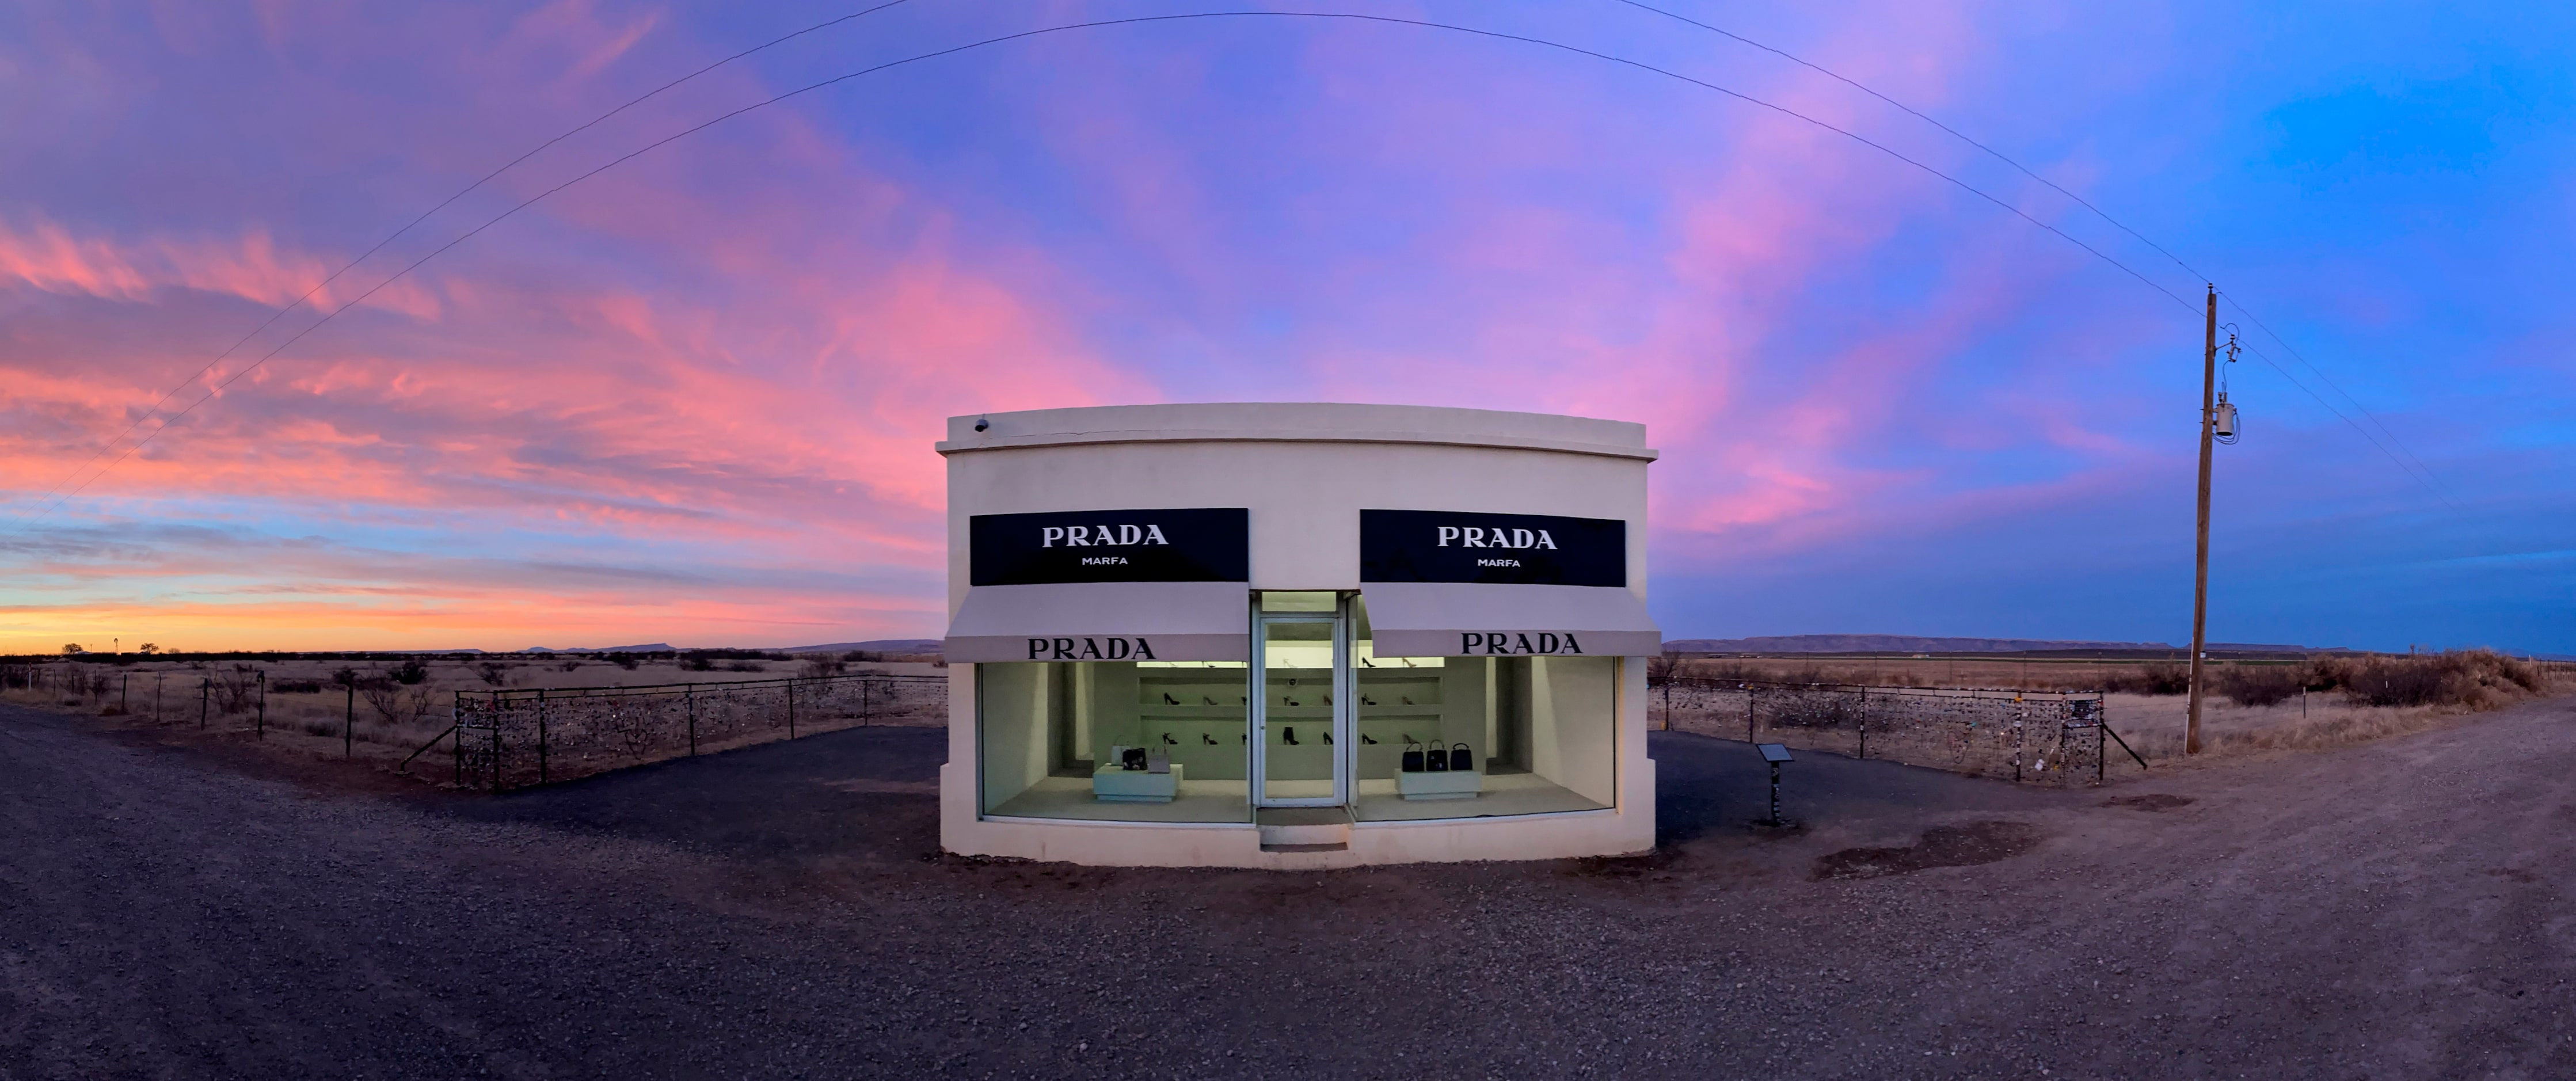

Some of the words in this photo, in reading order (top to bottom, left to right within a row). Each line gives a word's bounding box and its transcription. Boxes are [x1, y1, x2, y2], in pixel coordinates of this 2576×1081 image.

[1042, 524, 1169, 548] PRADA
[1437, 526, 1558, 550] PRADA
[1082, 557, 1128, 565] MARFA
[1477, 559, 1521, 568] MARFA
[1027, 637, 1156, 660] PRADA
[1461, 633, 1583, 654] PRADA
